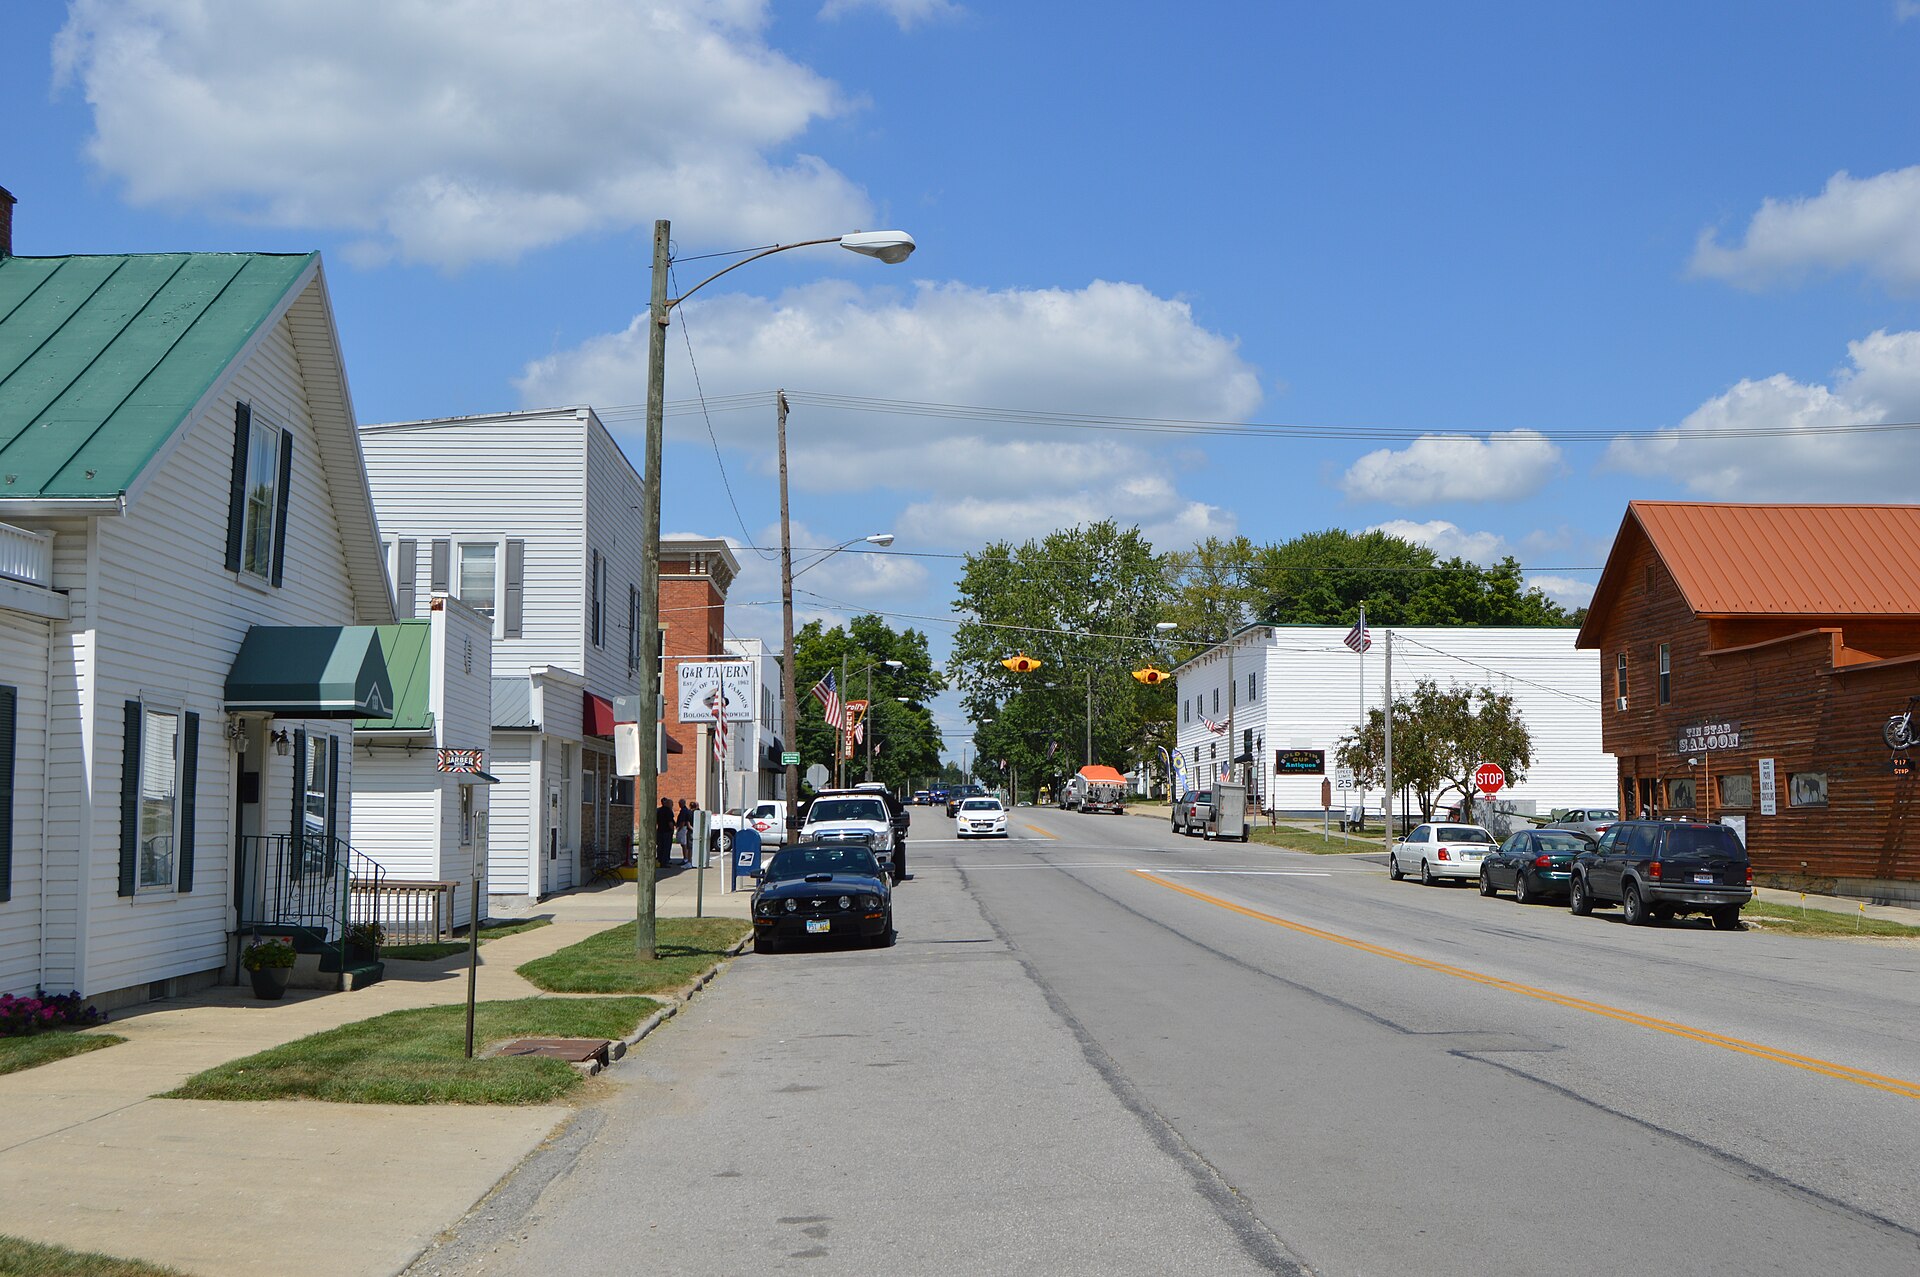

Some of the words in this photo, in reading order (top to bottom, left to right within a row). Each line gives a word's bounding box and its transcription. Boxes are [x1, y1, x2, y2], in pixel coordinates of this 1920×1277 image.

[682, 666, 703, 679] G&R
[699, 681, 709, 689] OF
[727, 682, 749, 709] FAMOUS
[845, 711, 853, 756] FURNITURE
[1686, 727, 1702, 738] TIN
[1704, 723, 1731, 736] STAR
[1679, 733, 1739, 752] SALOON
[445, 756, 474, 765] BARBER
[1283, 751, 1300, 759] OLD
[1303, 751, 1318, 759] TIN
[1338, 779, 1352, 788] 25
[1477, 773, 1502, 785] STOP
